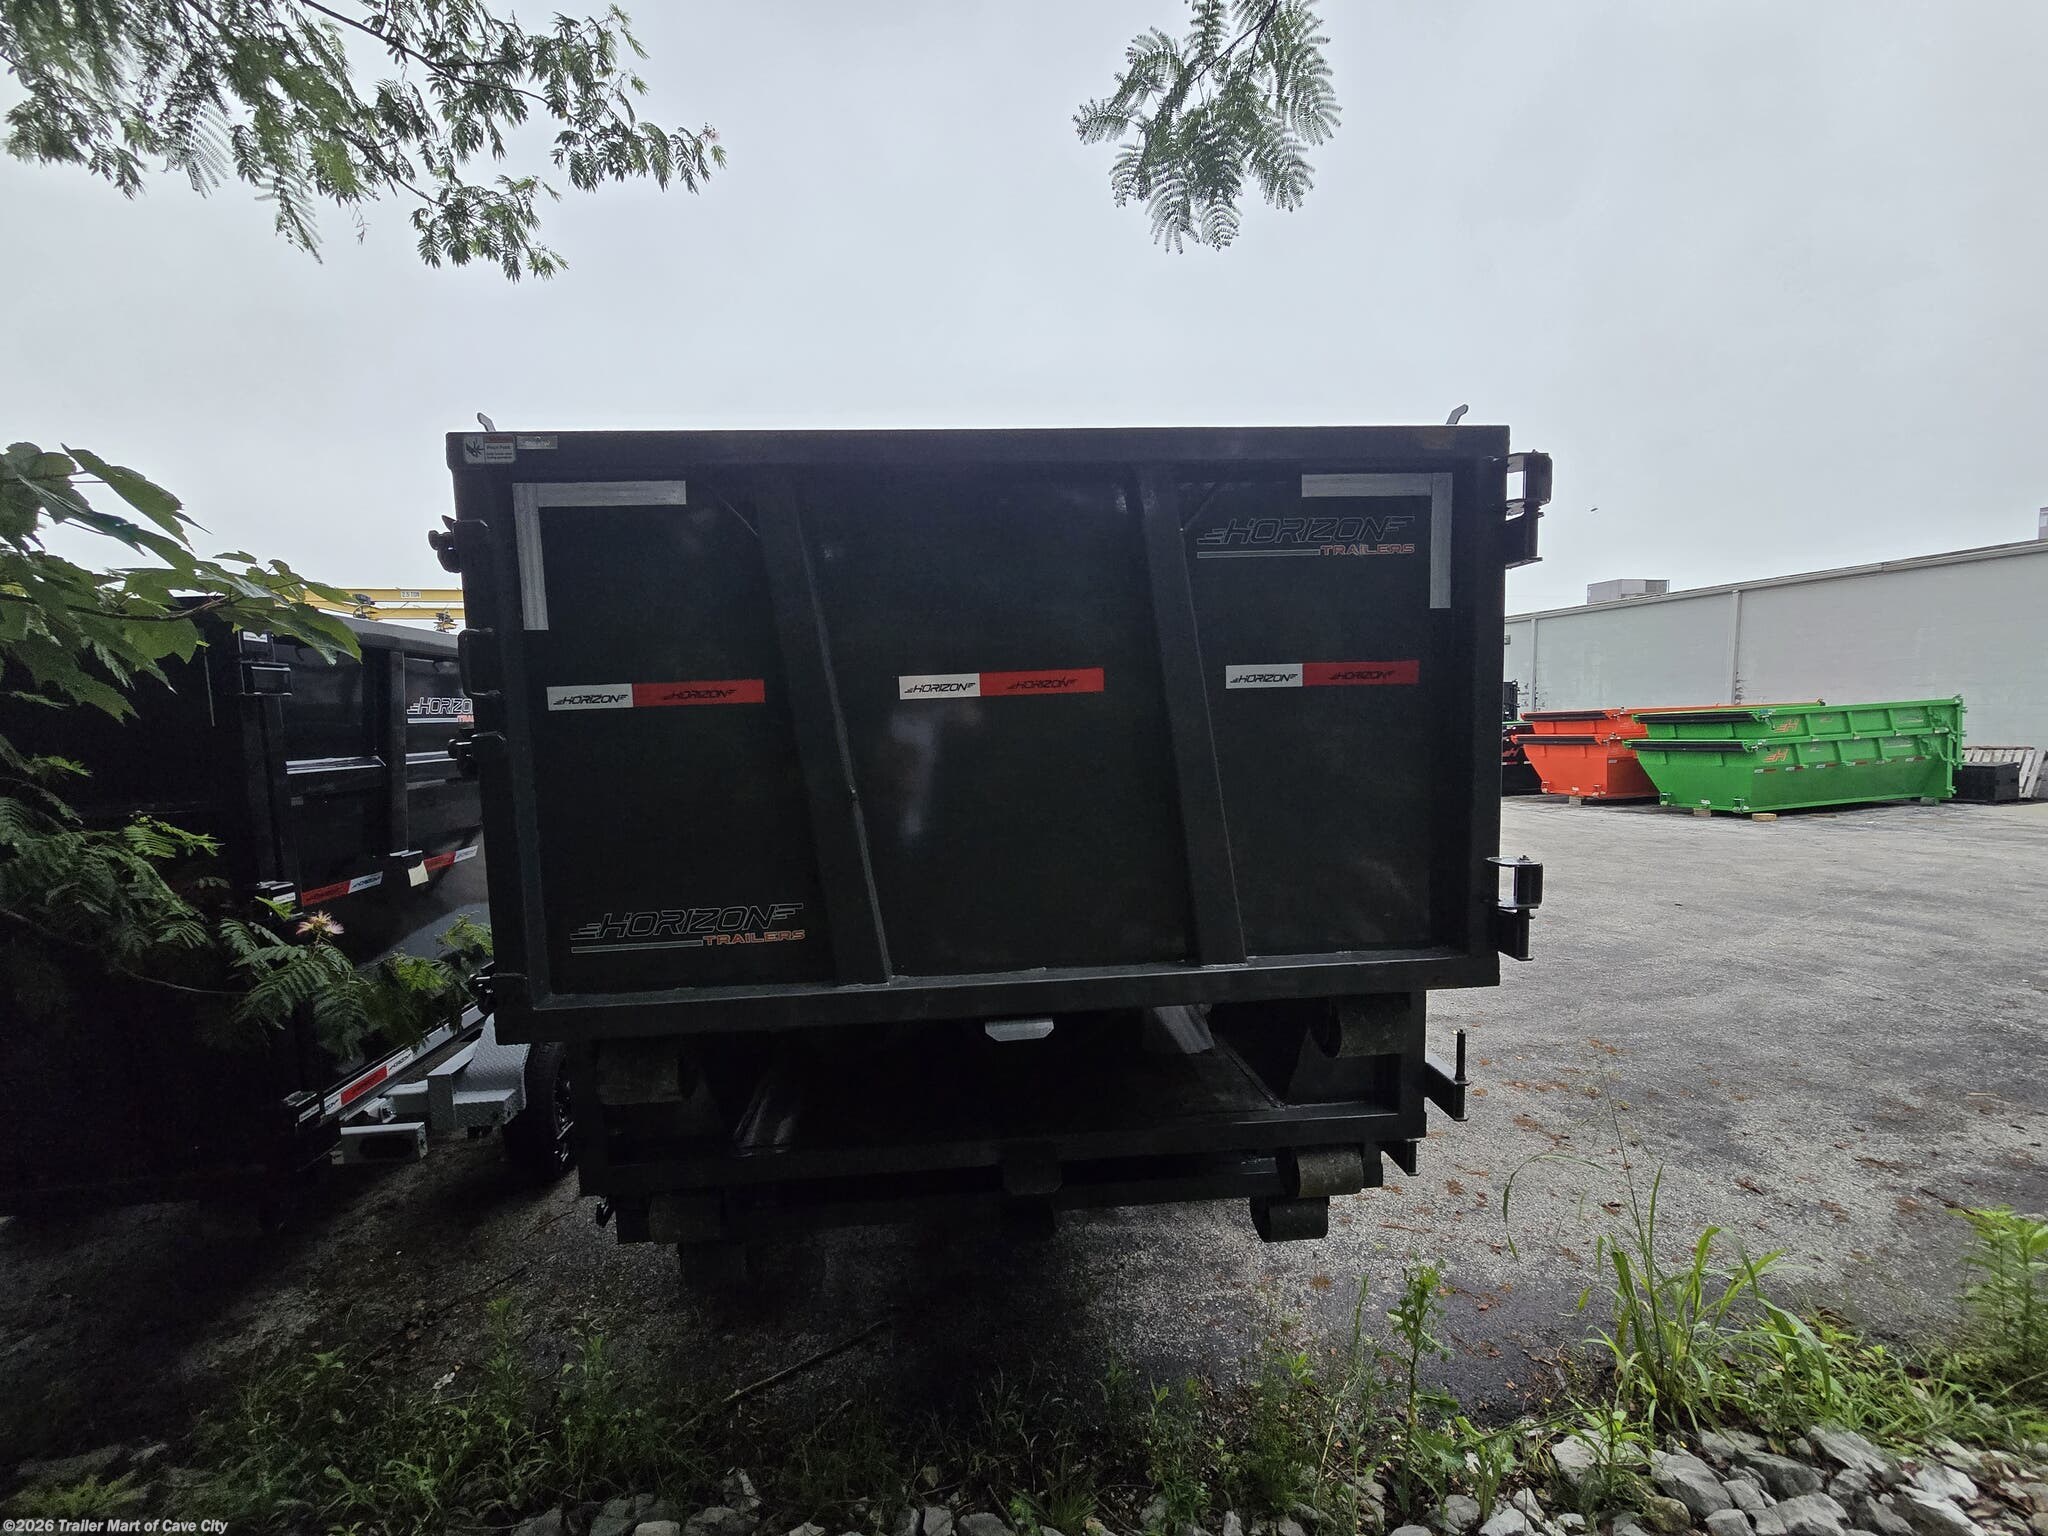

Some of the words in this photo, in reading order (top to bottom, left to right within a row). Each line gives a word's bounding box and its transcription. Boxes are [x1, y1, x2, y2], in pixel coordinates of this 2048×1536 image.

[1196, 516, 1414, 544] HORIZON
[1319, 543, 1414, 556] TRAILERS
[1229, 673, 1298, 684] HORIZON
[904, 682, 976, 694] HORIZON
[408, 697, 474, 715] HORIZO
[554, 694, 628, 706] HORIZON
[570, 903, 804, 941] HORIZON
[703, 930, 806, 946] TRAILERS
